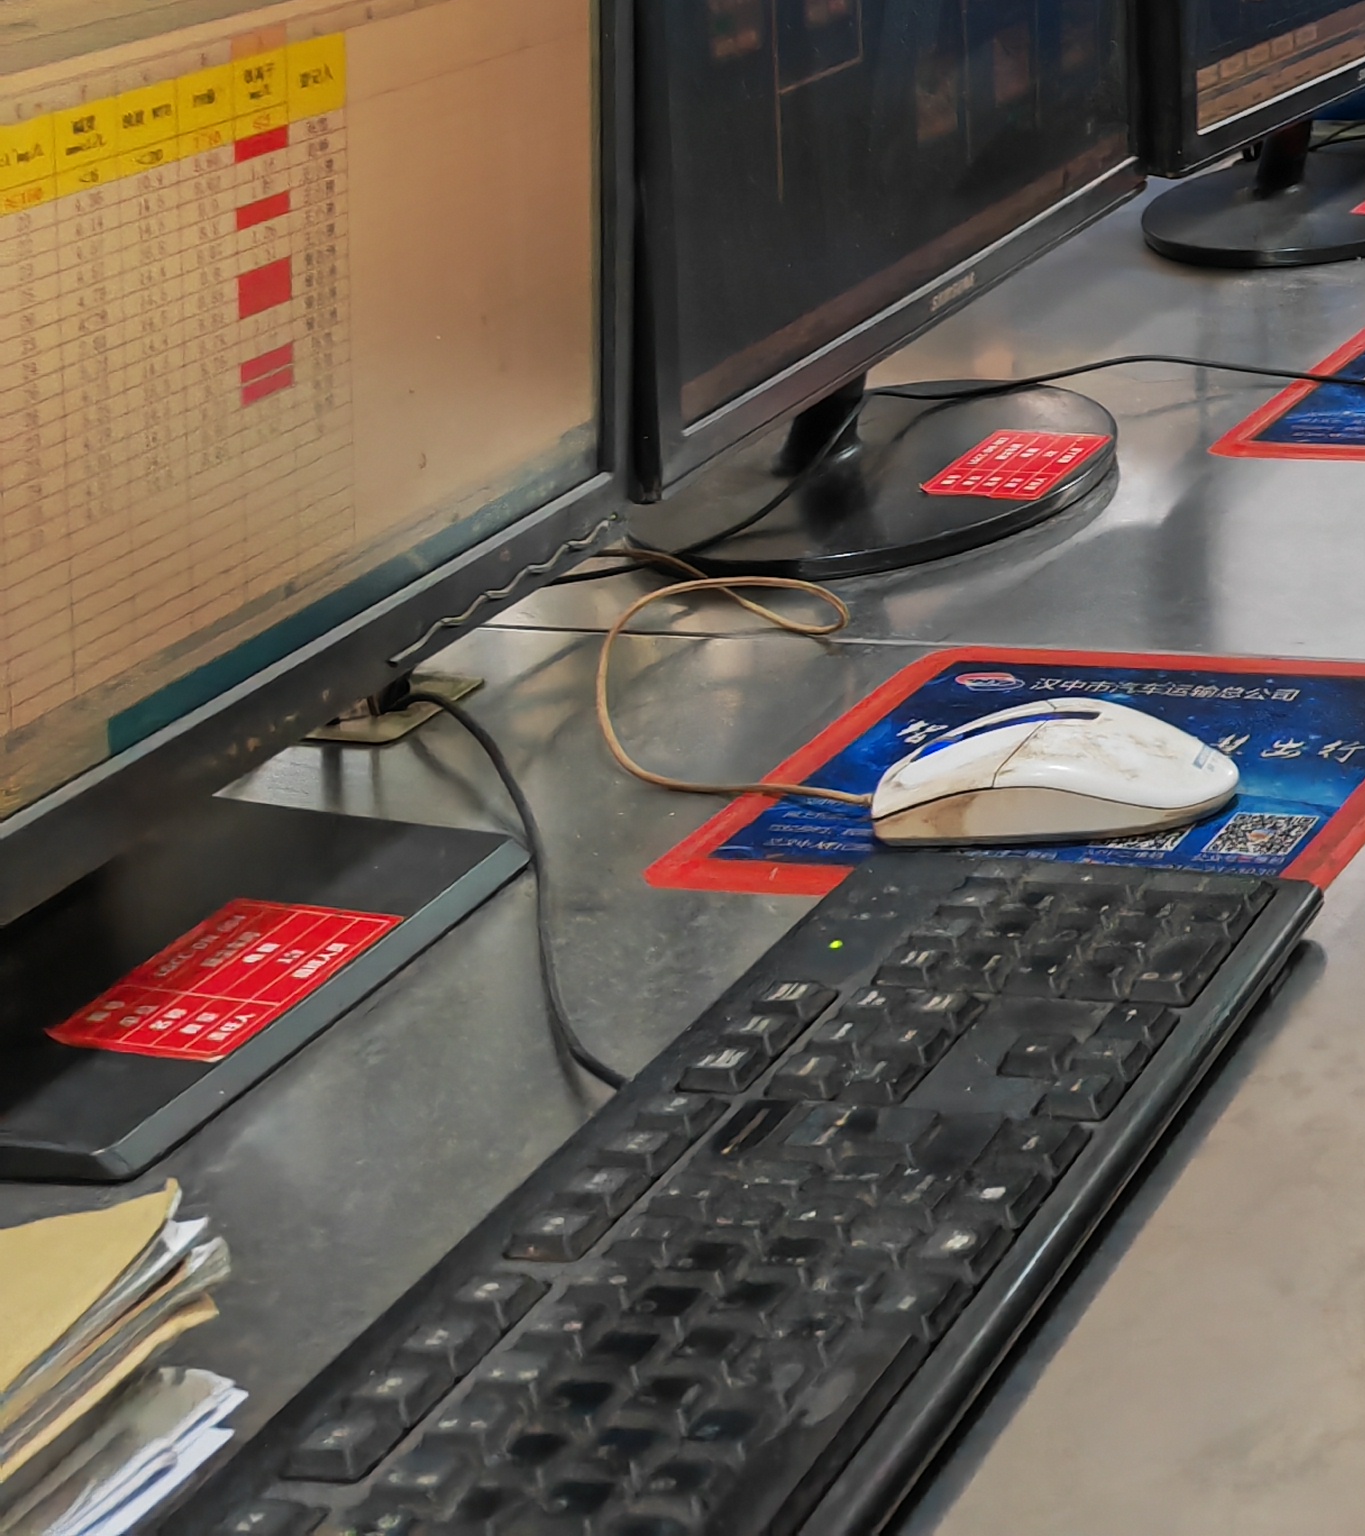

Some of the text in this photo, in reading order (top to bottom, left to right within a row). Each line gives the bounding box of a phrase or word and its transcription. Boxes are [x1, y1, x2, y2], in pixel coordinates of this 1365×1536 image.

[1029, 676, 1300, 703] 汉中市汽车运输总公司
